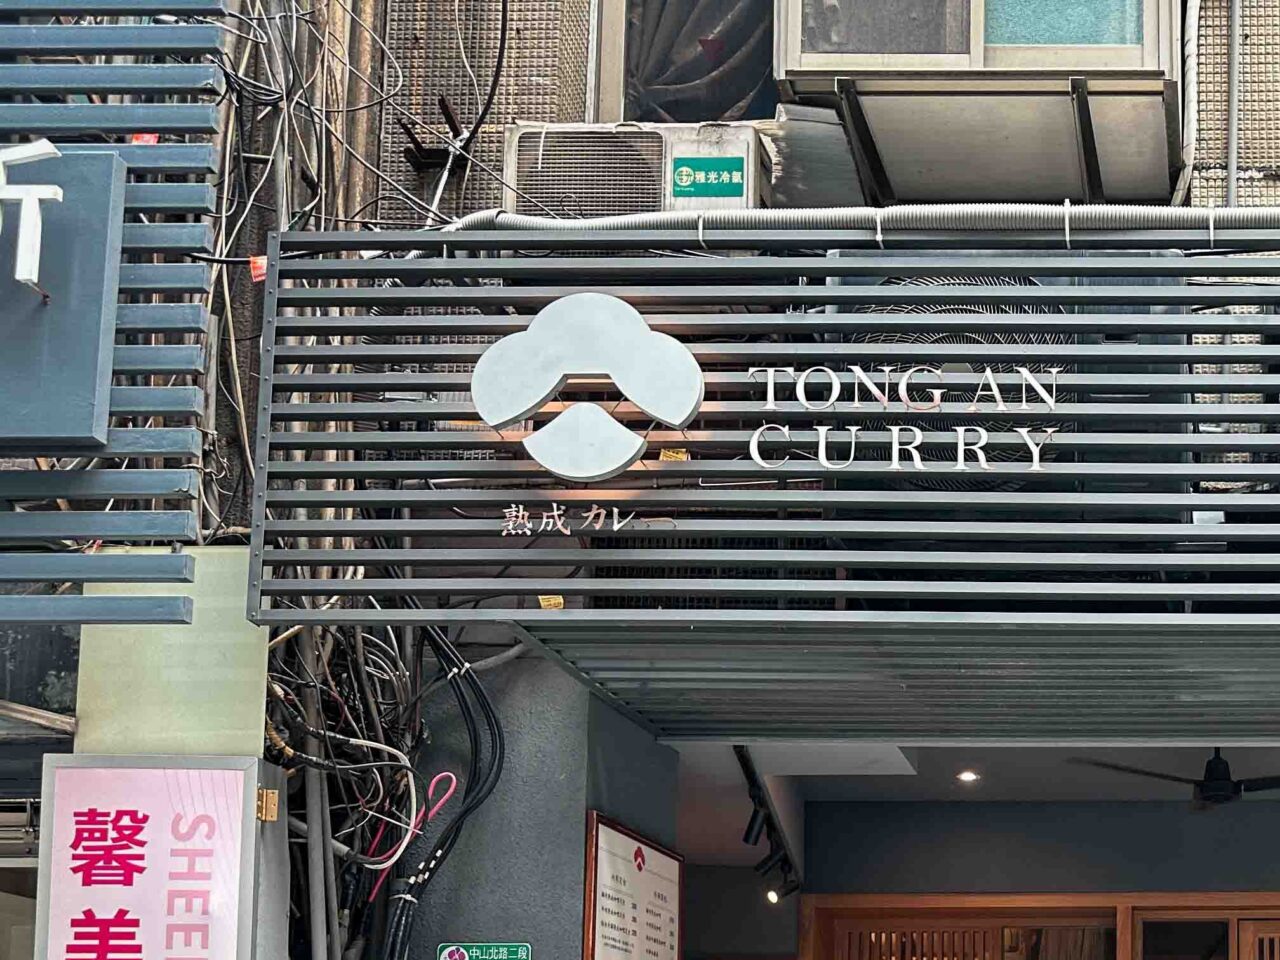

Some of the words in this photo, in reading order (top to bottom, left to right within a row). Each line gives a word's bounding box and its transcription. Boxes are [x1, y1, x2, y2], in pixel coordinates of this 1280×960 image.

[695, 171, 743, 184] 雅光冷氣
[748, 366, 947, 411] TONG
[967, 366, 1065, 411] AN
[749, 423, 1060, 471] CURRY
[469, 946, 528, 960] 中山北路二段
